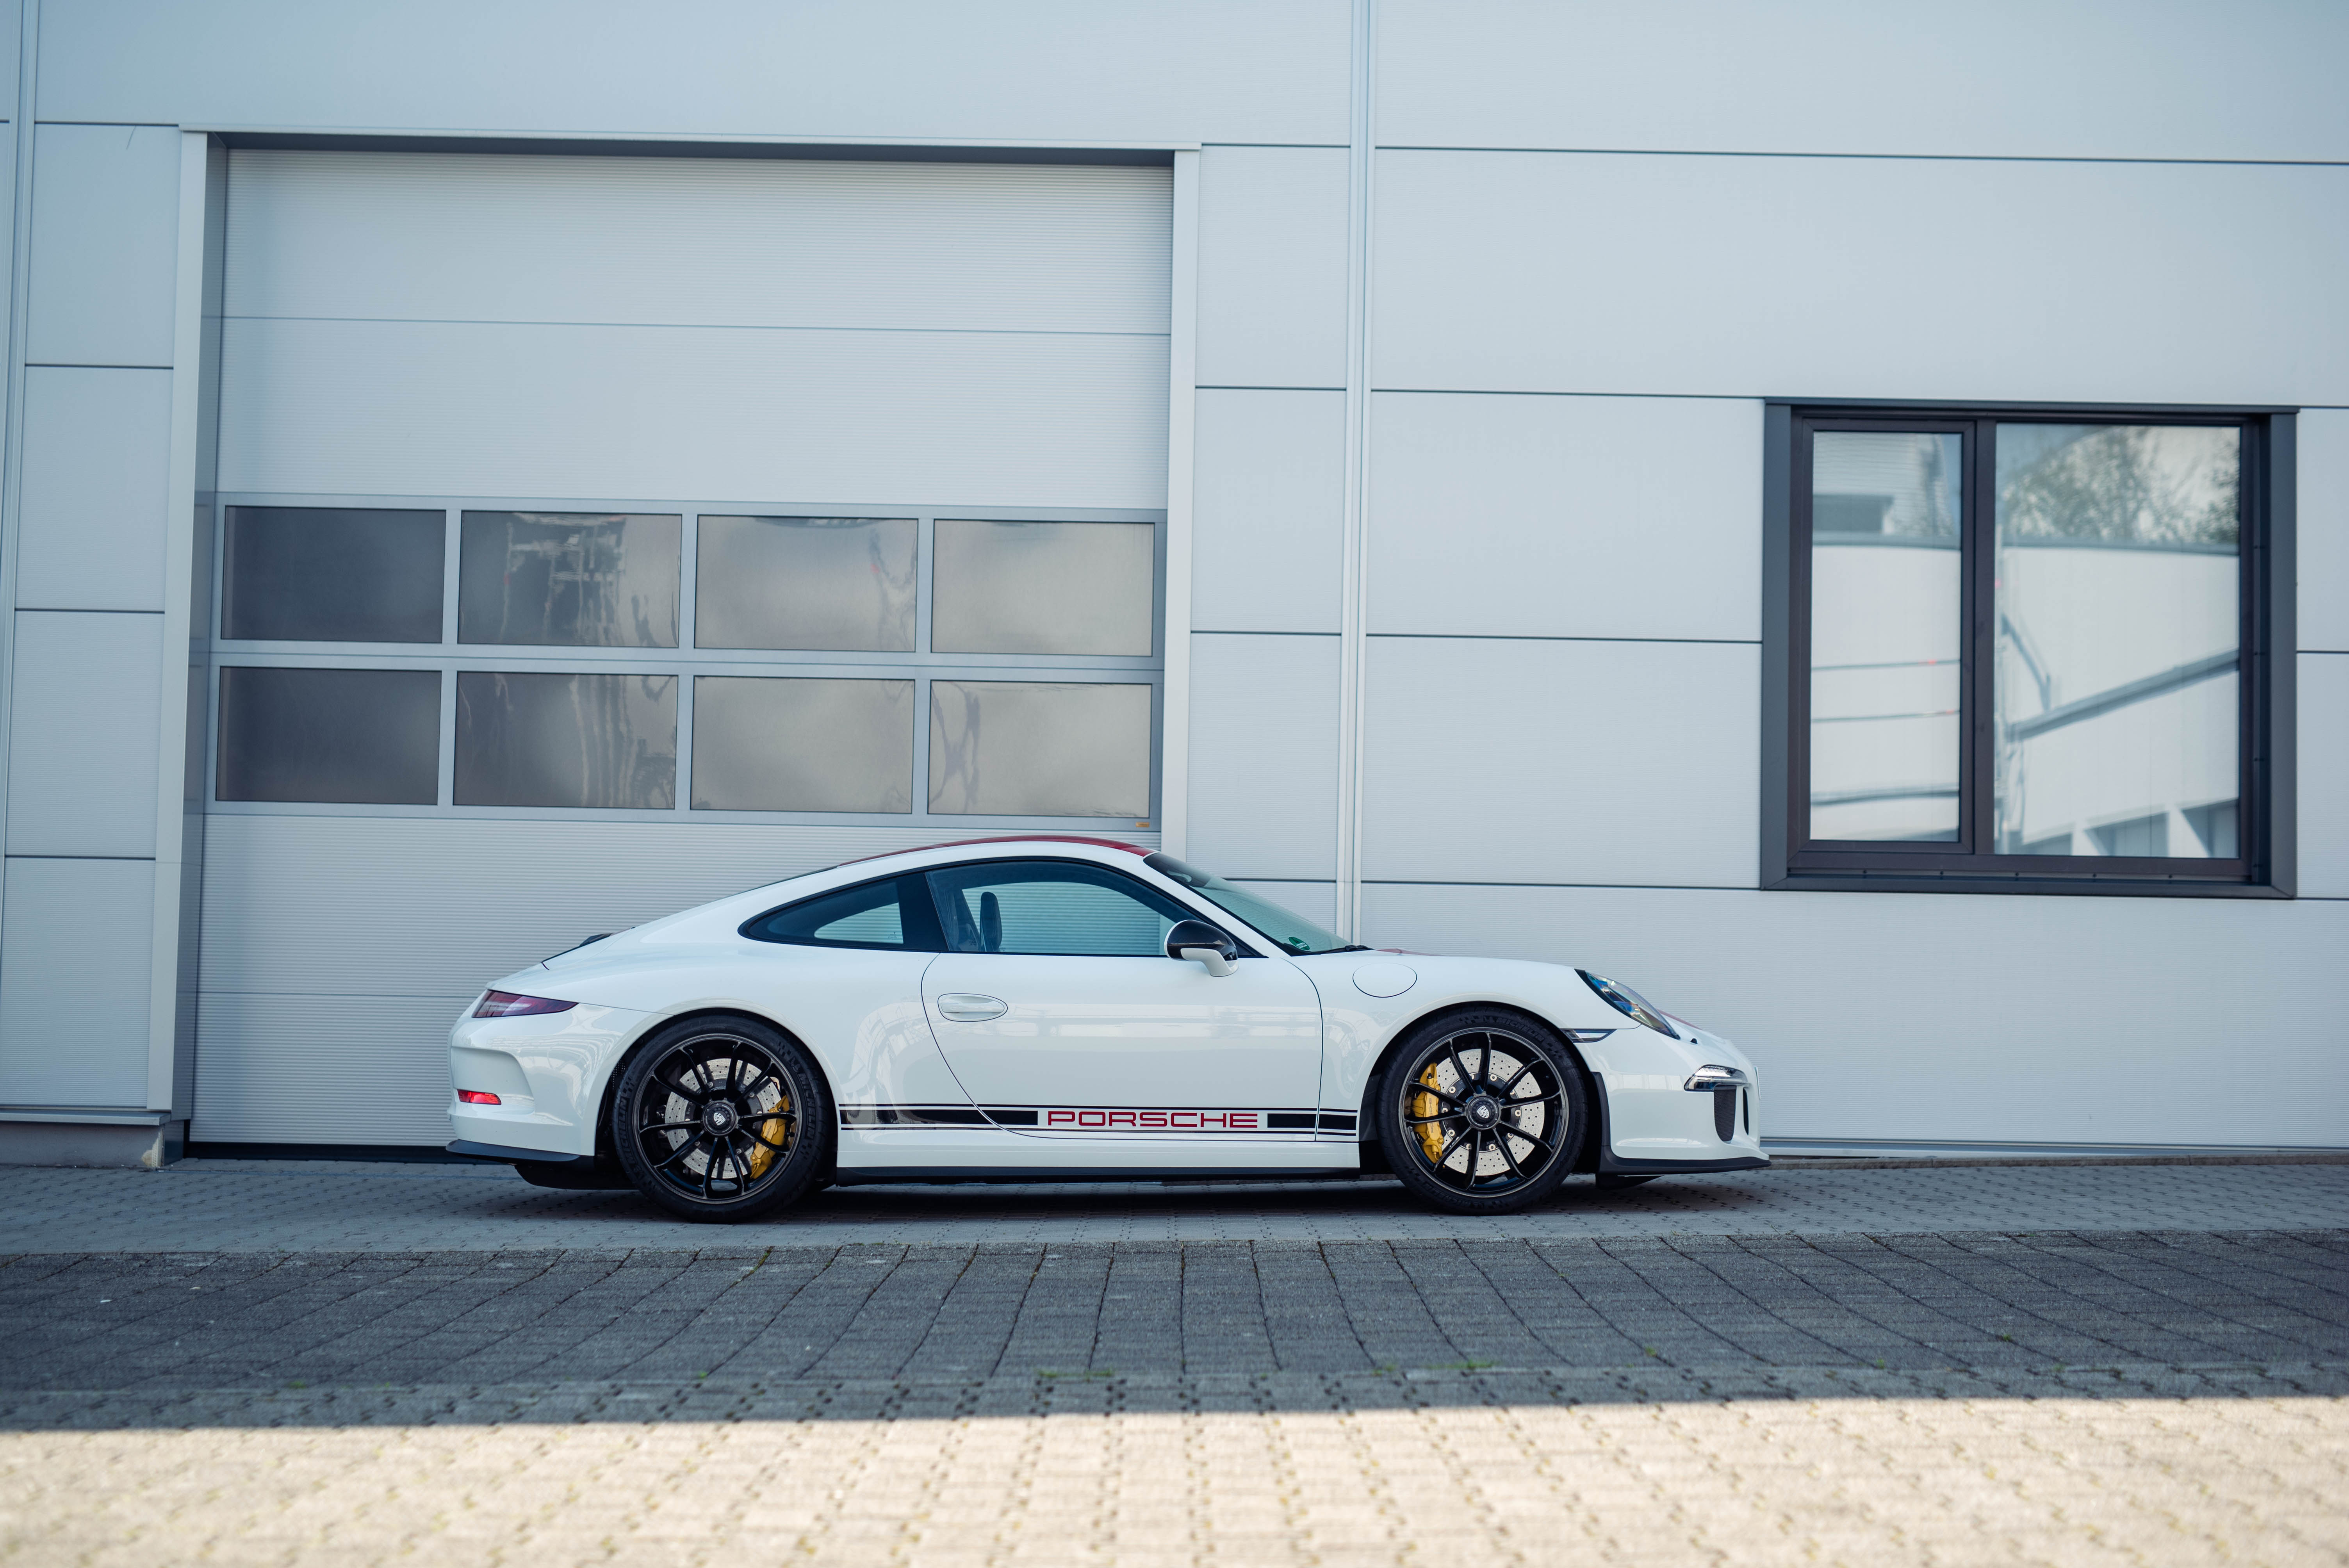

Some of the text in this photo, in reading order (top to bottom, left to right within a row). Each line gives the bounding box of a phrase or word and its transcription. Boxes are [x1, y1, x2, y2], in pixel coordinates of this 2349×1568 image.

[1496, 1017, 1544, 1042] MICHELIN
[798, 1073, 815, 1140] MICHELIN
[1048, 1111, 1258, 1128] PORSCHE
[619, 1098, 636, 1164] MICHELIN
